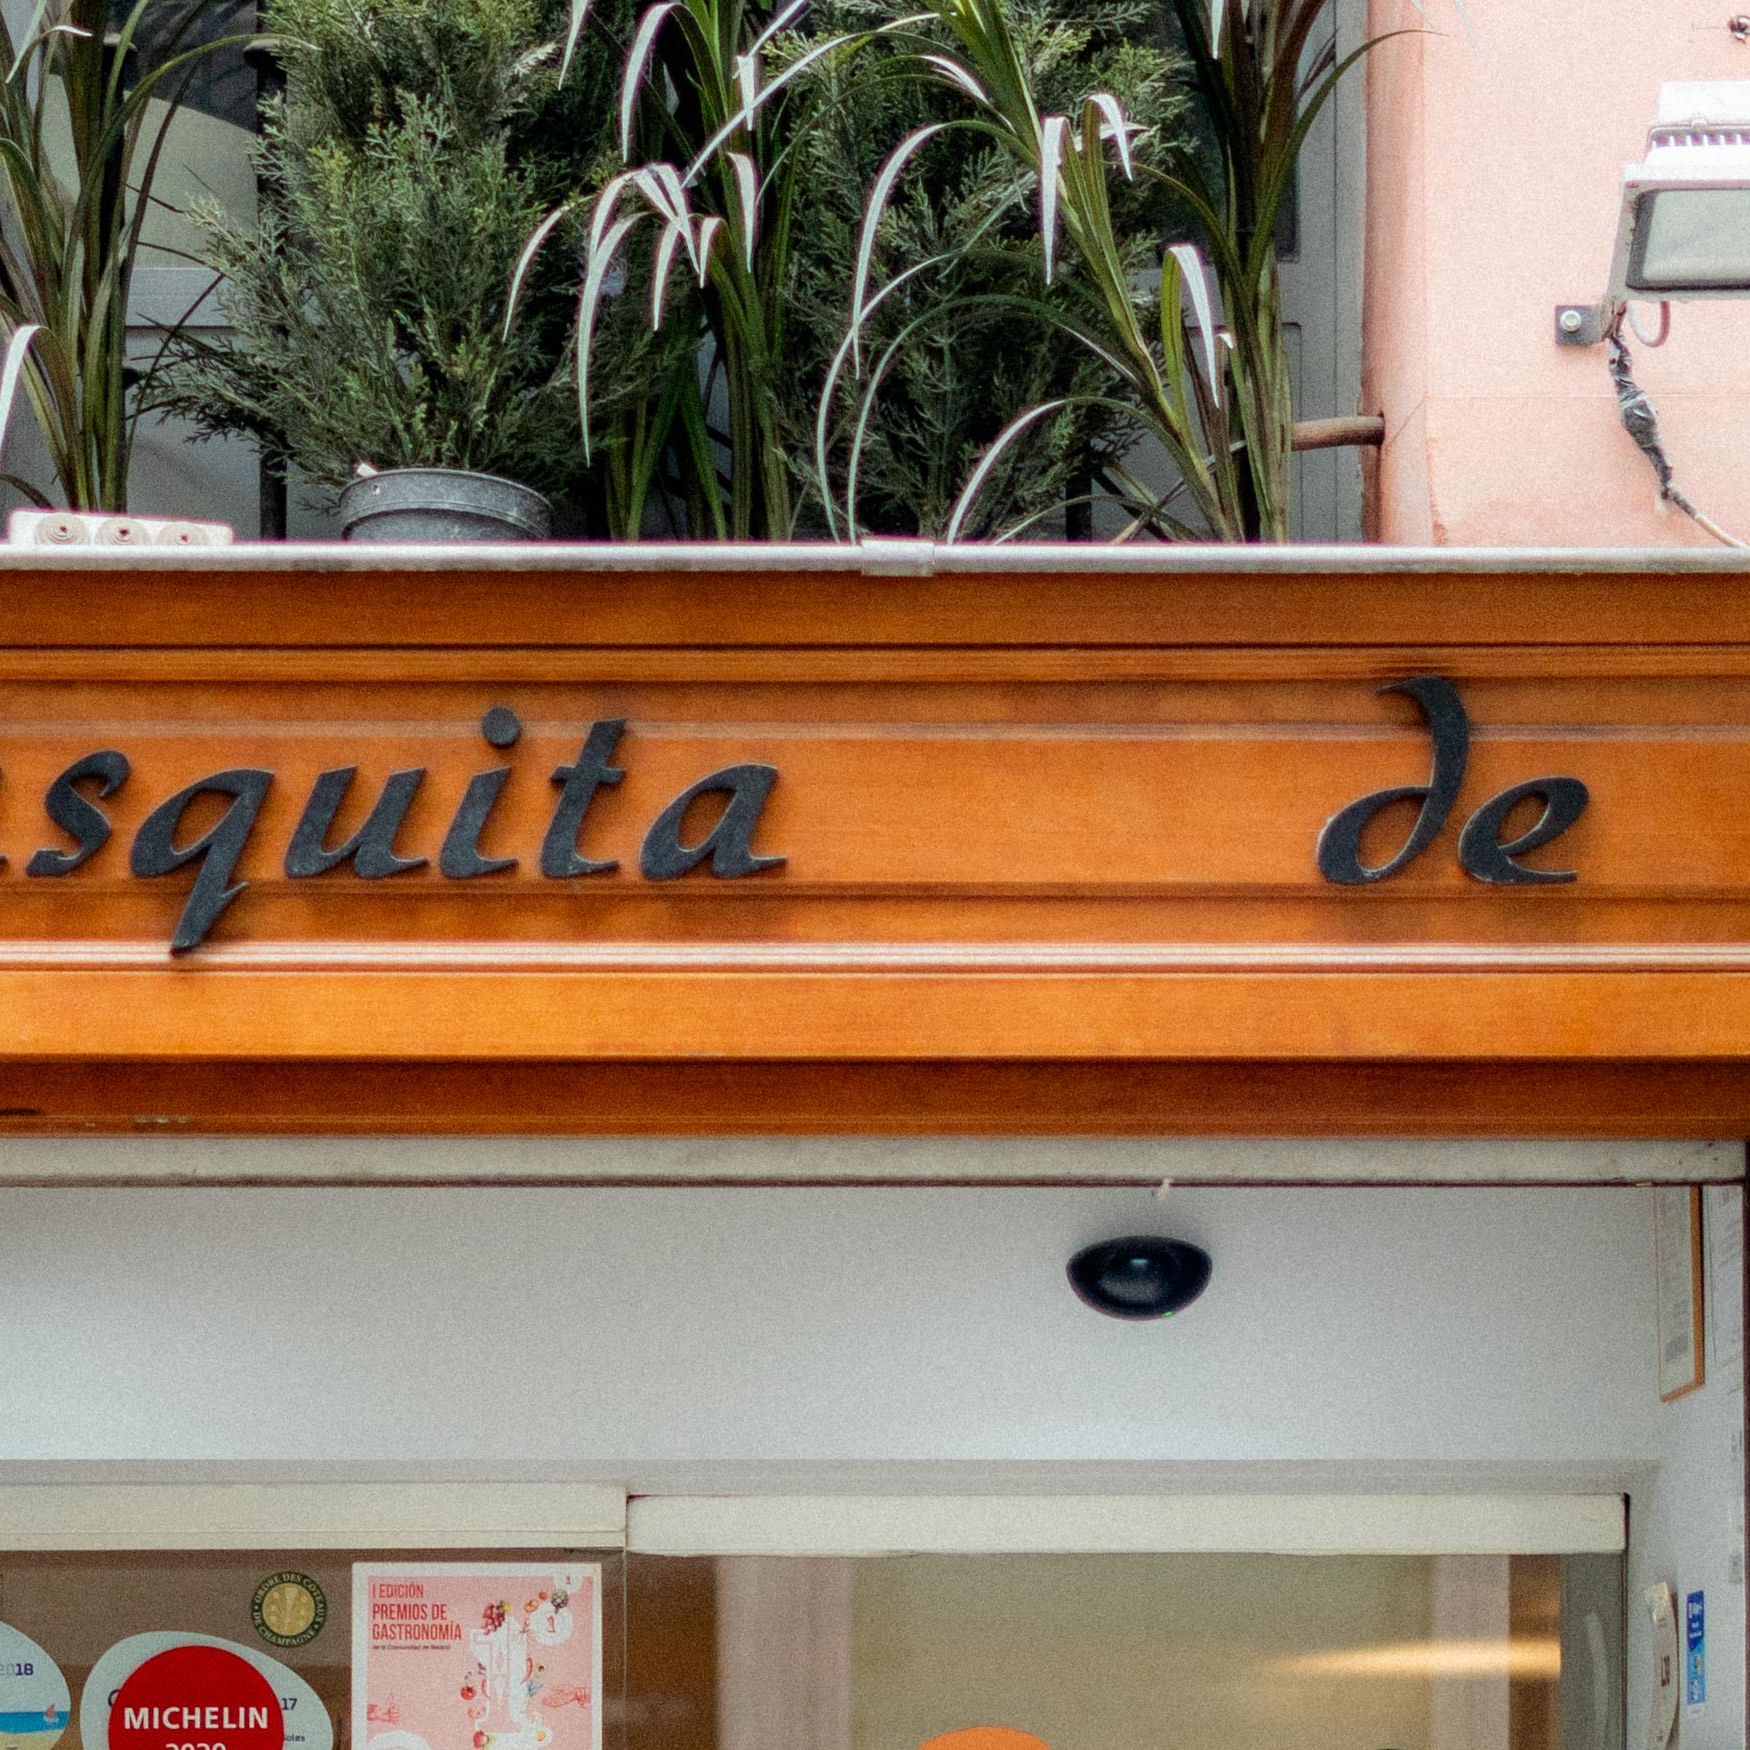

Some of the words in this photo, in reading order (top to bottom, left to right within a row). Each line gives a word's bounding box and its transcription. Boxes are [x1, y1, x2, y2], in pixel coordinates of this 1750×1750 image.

[1316, 674, 1591, 887] de
[379, 1581, 424, 1598] EDICIÓN
[372, 1603, 428, 1620] PREMIOS
[432, 1603, 447, 1620] DE
[372, 1621, 462, 1641] GASTRONOMÍA
[123, 1706, 269, 1729] MICHELIN
